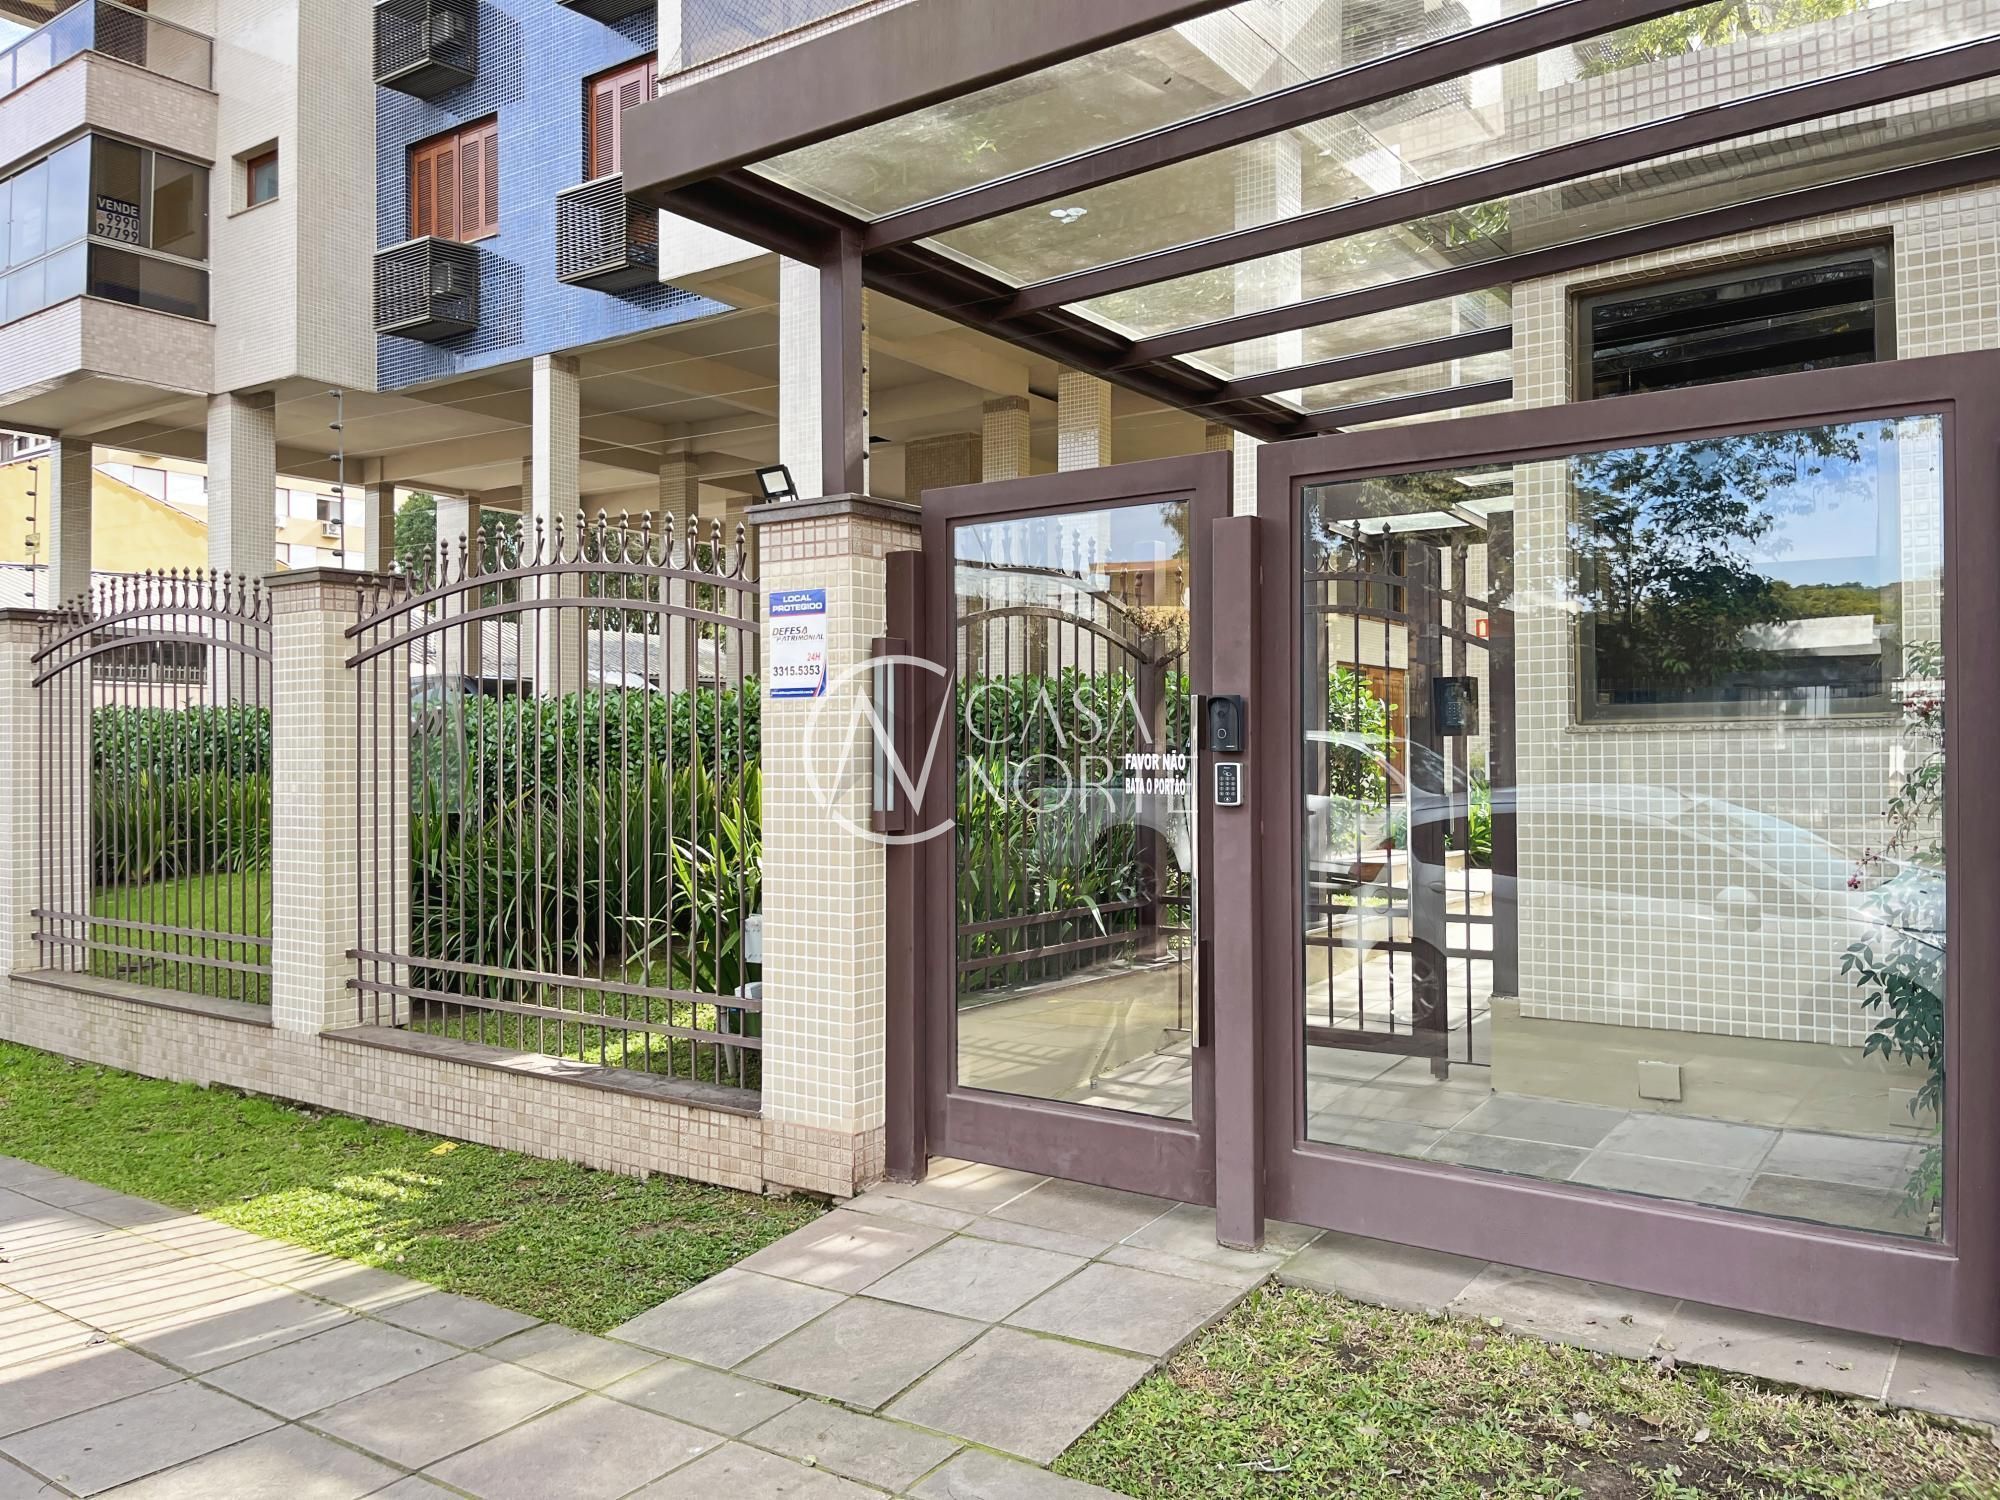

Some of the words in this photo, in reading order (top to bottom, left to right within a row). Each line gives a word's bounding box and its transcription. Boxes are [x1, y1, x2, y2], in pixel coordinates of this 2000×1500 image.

[98, 197, 138, 216] VENDE
[106, 213, 138, 231] 9990
[98, 223, 138, 242] 97799
[782, 594, 812, 603] LOCAL
[772, 602, 823, 612] PROTEGIDO
[772, 626, 808, 636] DEFESA
[776, 634, 824, 642] PATRIMONIAL
[807, 652, 821, 662] 24H
[773, 665, 821, 676] 3315.5353
[1125, 753, 1160, 770] FAVOR
[1162, 750, 1186, 770] NÃO
[1125, 777, 1145, 795] BATA
[1146, 778, 1152, 795] O
[1154, 775, 1186, 796] PORTÃO
